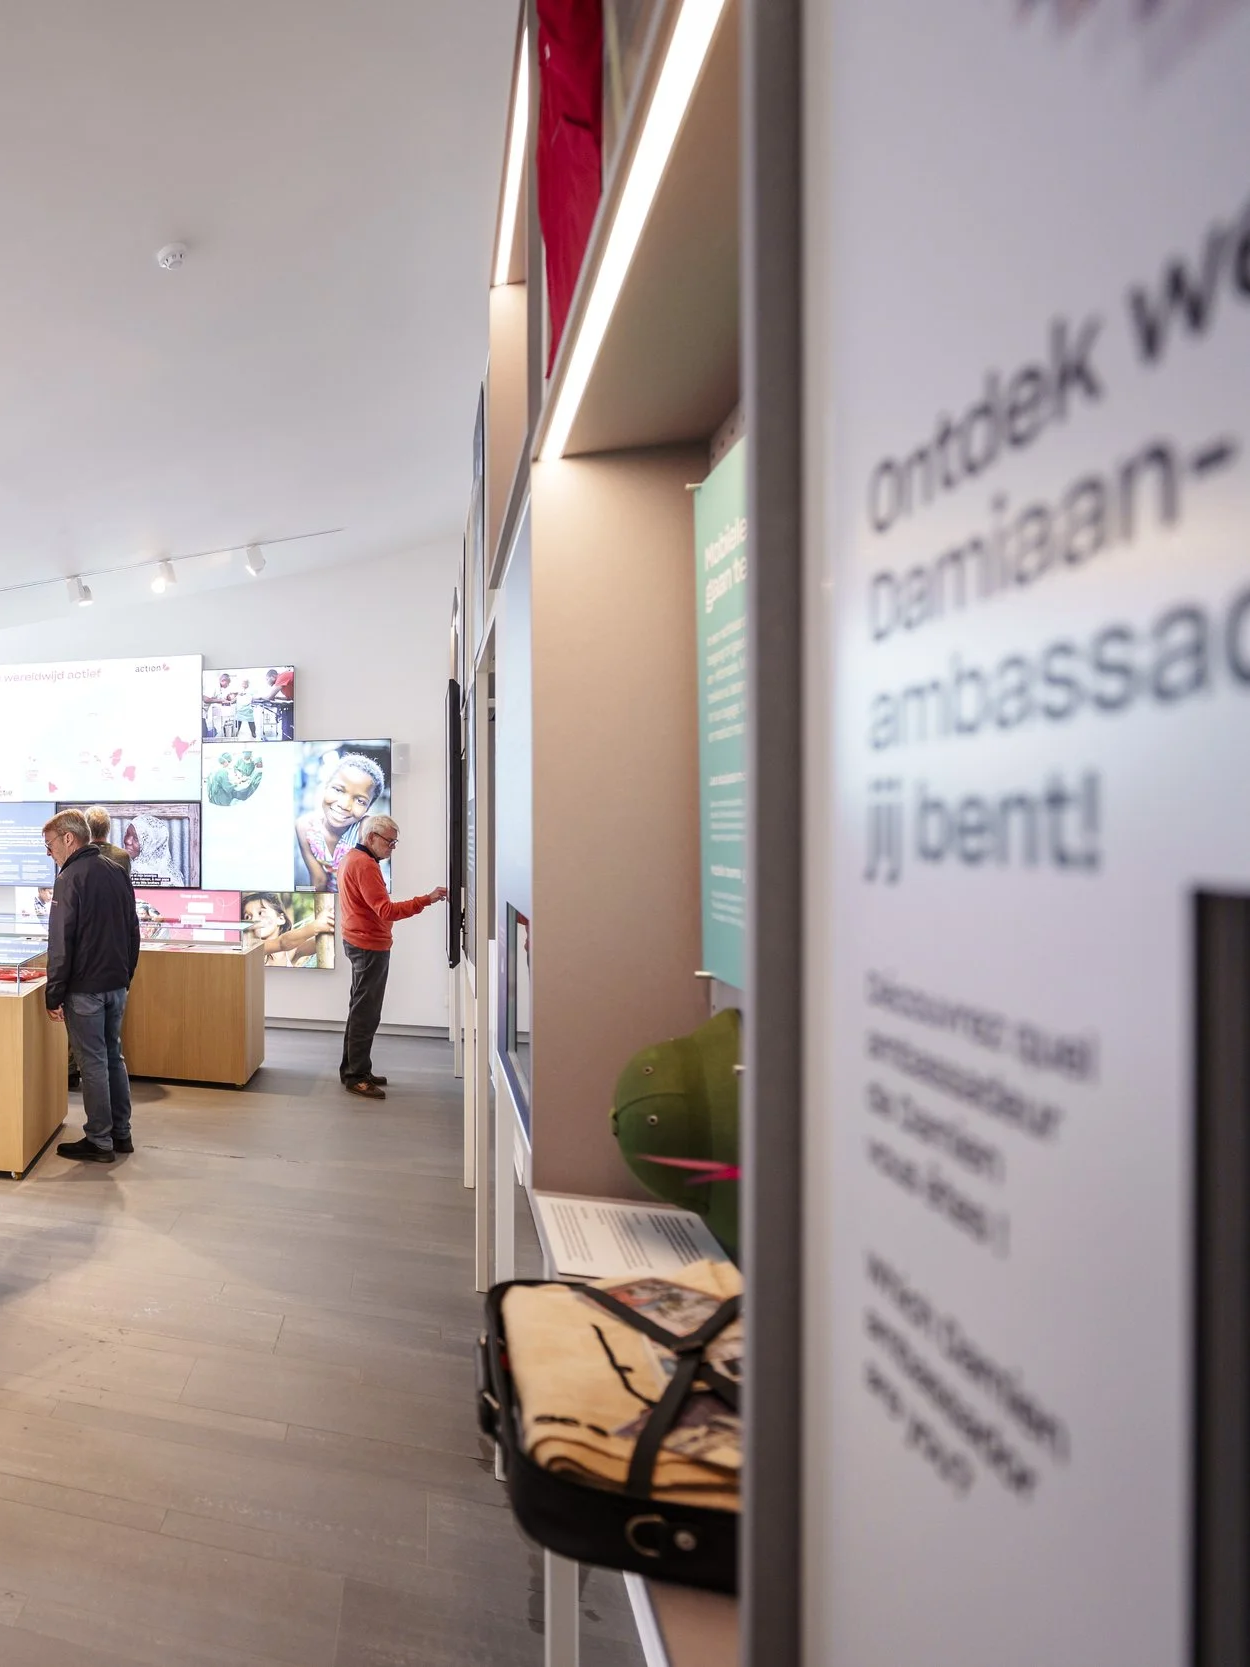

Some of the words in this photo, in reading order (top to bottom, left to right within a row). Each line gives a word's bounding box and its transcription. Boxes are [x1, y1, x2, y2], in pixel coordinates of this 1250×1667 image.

[866, 313, 1103, 534] Ontdek
[4, 671, 65, 683] wereldwijd
[67, 668, 102, 680] actief
[135, 664, 161, 673] action
[915, 768, 1101, 874] bent!
